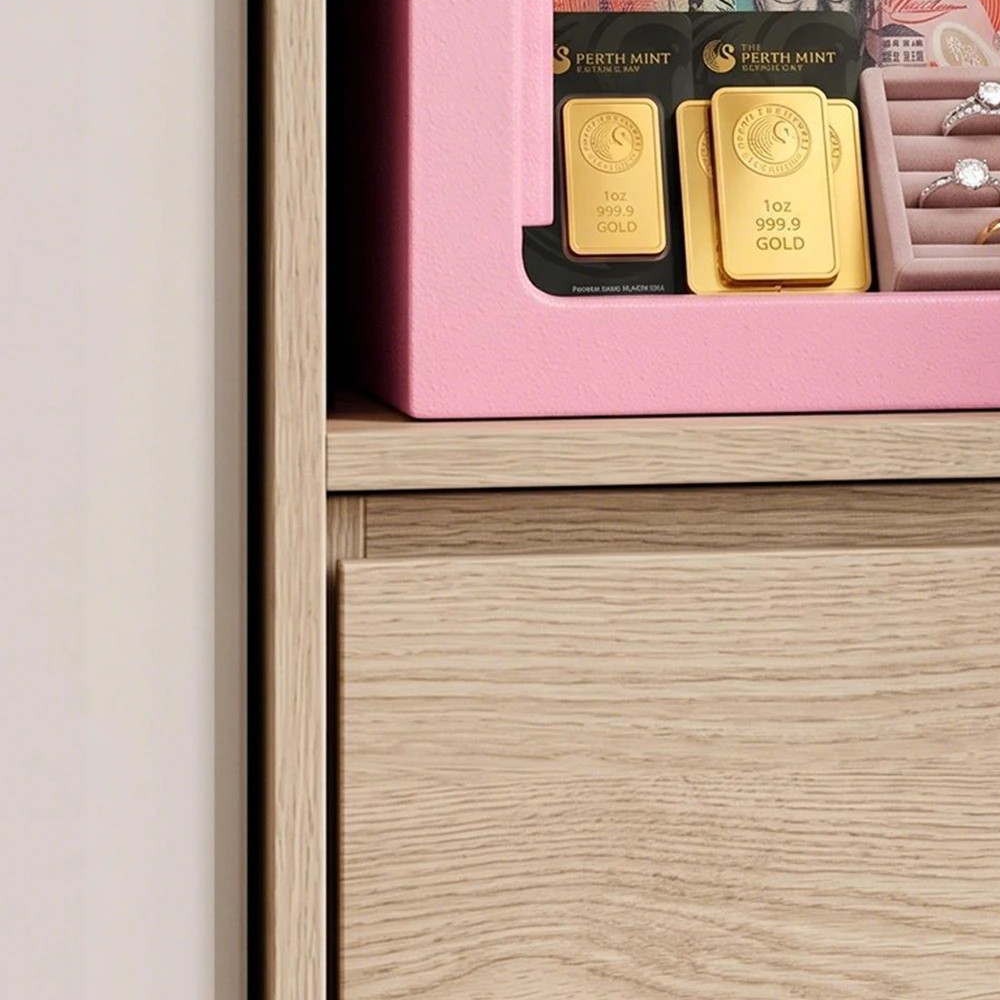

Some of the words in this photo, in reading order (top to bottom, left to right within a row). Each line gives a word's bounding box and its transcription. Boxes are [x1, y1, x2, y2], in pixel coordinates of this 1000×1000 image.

[741, 43, 761, 52] THE
[576, 52, 626, 66] PERTH
[630, 52, 672, 65] MINT
[741, 51, 791, 64] PERTH
[795, 51, 837, 64] MINT
[604, 190, 628, 202] 1oz
[596, 204, 635, 218] 999.9
[764, 199, 793, 213] 1oz
[596, 220, 638, 233] GOLD
[755, 217, 802, 232] 999.9
[755, 236, 806, 251] GOLD
